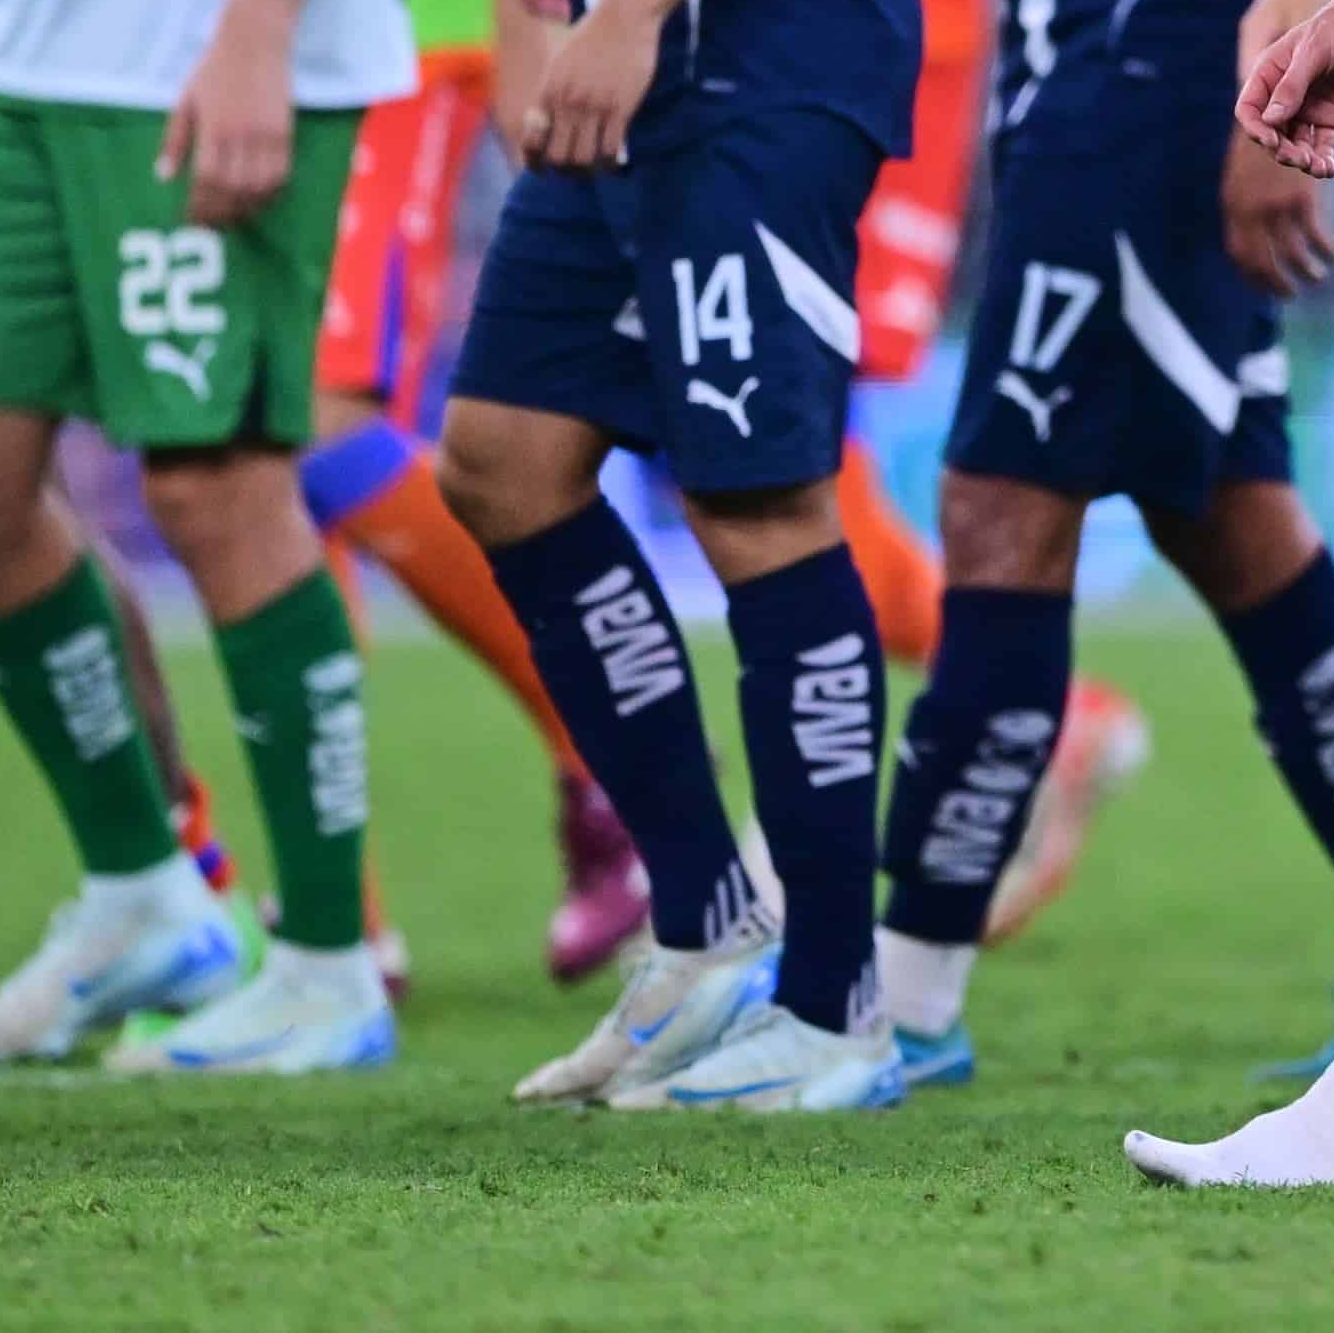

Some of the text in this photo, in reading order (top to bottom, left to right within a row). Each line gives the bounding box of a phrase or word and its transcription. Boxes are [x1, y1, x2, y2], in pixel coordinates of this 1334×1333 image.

[118, 226, 226, 336] 22
[672, 254, 754, 365] 14
[1009, 261, 1102, 373] 17
